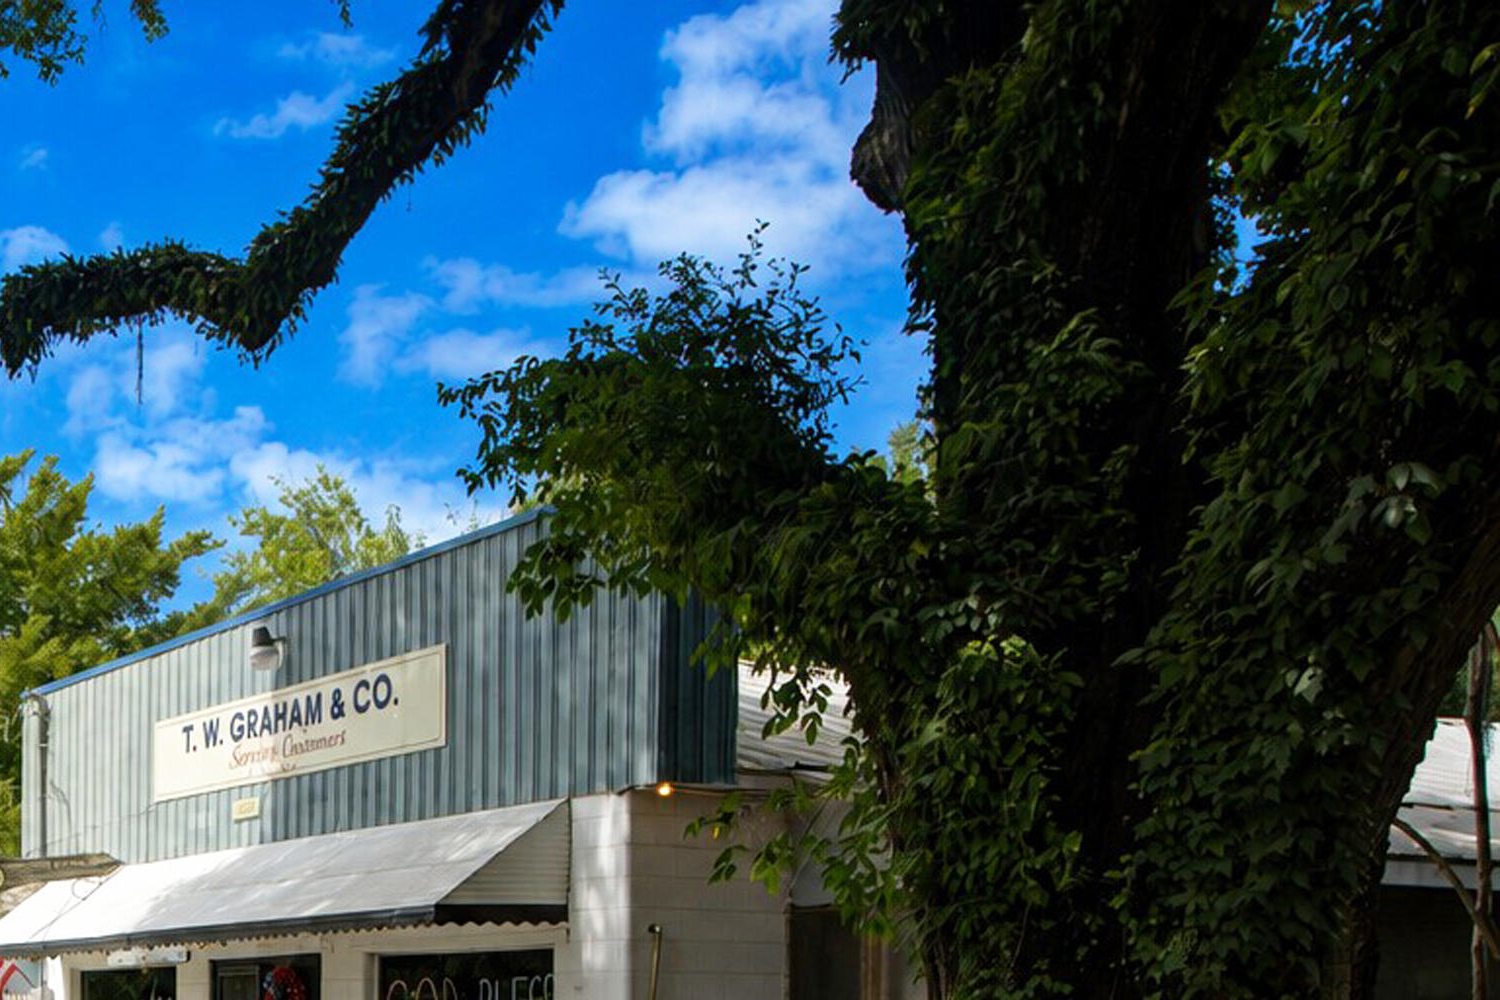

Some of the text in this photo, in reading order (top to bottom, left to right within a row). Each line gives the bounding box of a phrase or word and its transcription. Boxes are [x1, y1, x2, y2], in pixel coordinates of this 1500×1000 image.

[182, 673, 399, 753] T. W. GRAHAM & CO.
